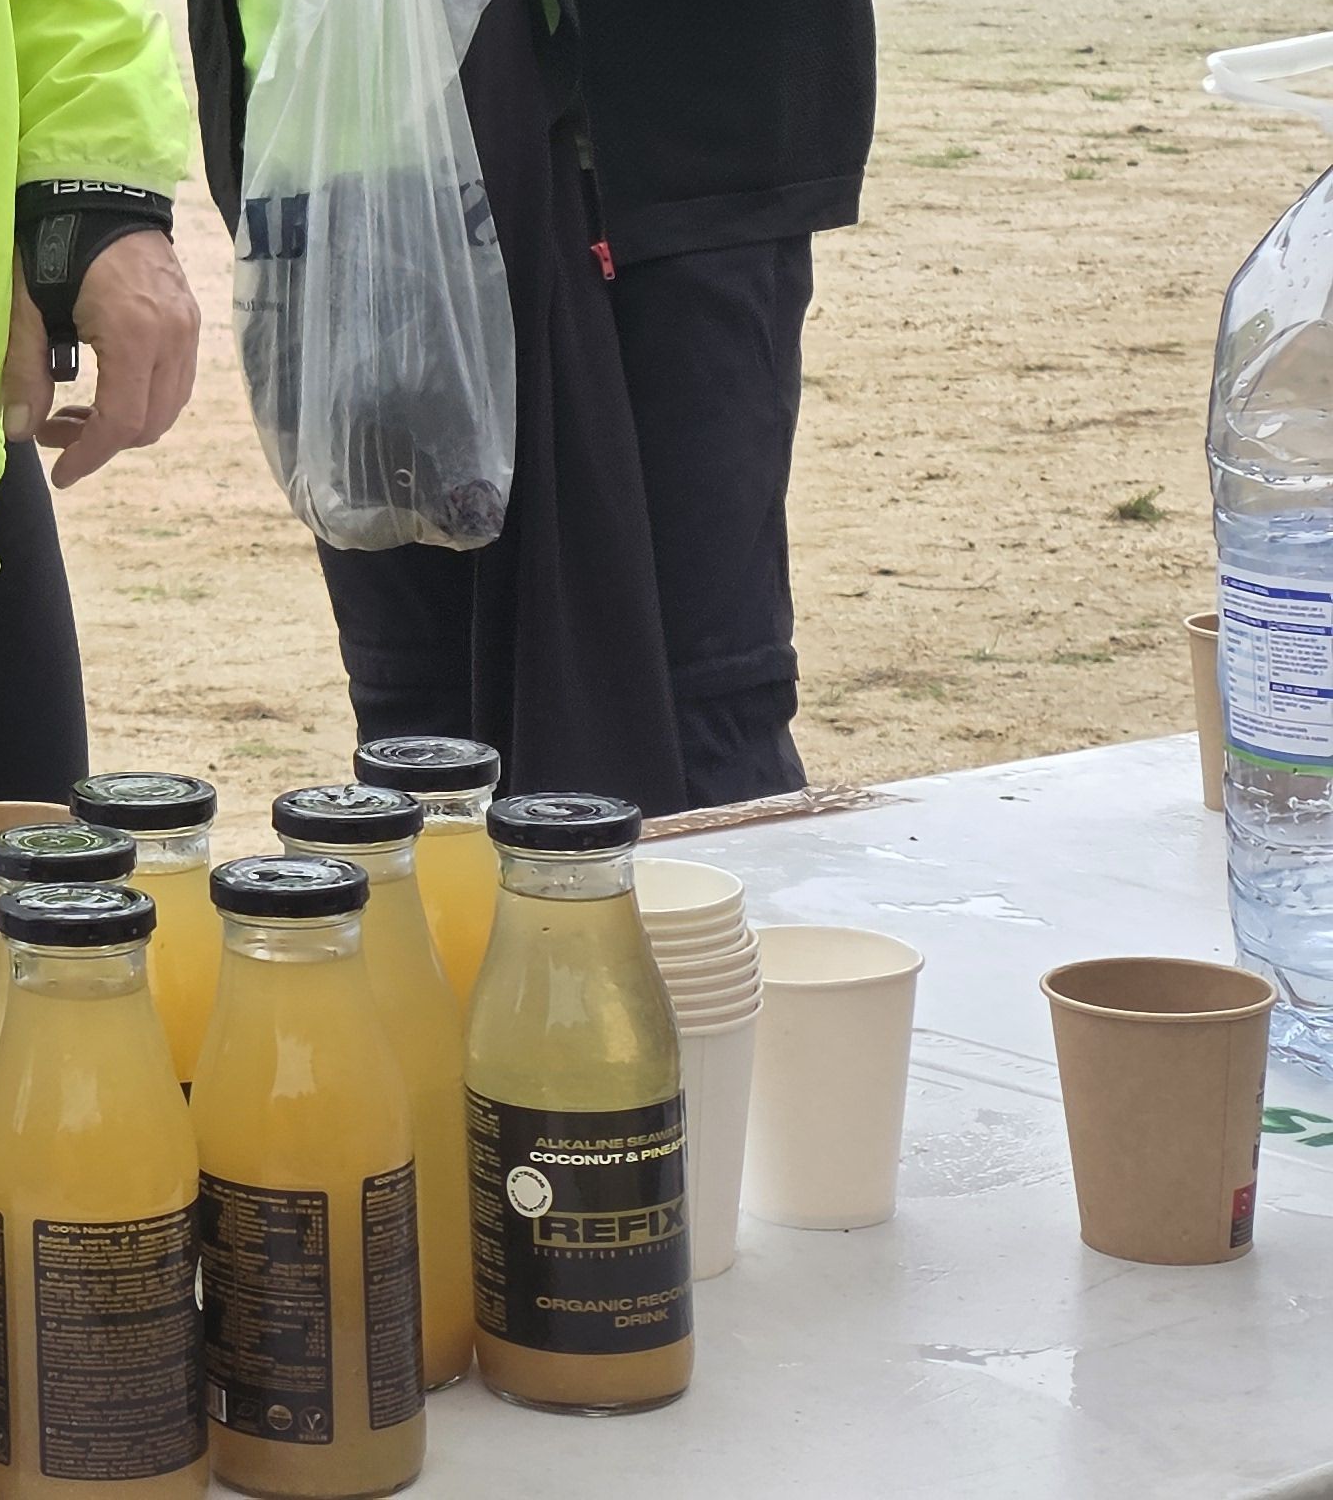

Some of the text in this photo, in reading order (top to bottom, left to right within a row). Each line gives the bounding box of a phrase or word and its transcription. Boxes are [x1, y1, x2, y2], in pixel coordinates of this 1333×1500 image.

[535, 1137, 624, 1151] ALKALINE
[529, 1151, 623, 1166] COCONUT
[626, 1152, 639, 1163] &
[537, 1206, 685, 1244] REFIX
[536, 1296, 632, 1313] ORGANIC
[615, 1308, 669, 1328] DRINK
